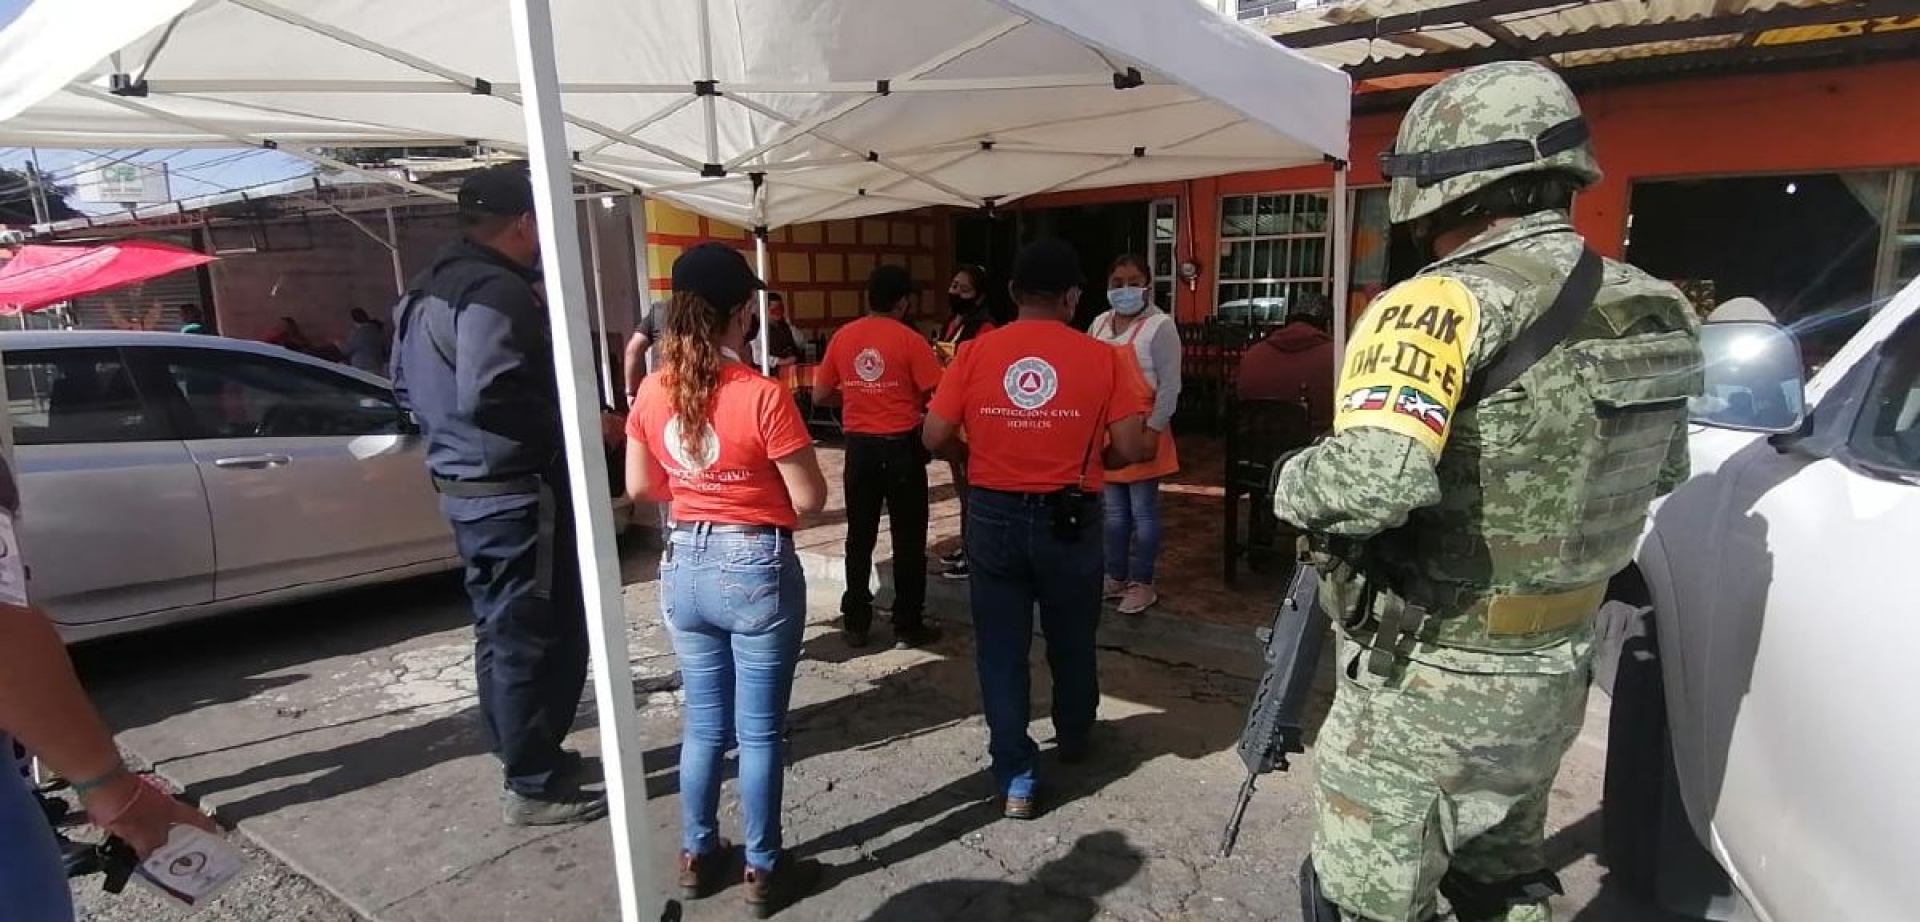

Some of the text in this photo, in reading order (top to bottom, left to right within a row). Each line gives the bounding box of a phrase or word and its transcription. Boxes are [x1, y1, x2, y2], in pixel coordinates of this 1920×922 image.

[1375, 303, 1464, 344] PLAN
[1349, 340, 1457, 397] DN-III-E
[1051, 409, 1081, 417] CIVIL
